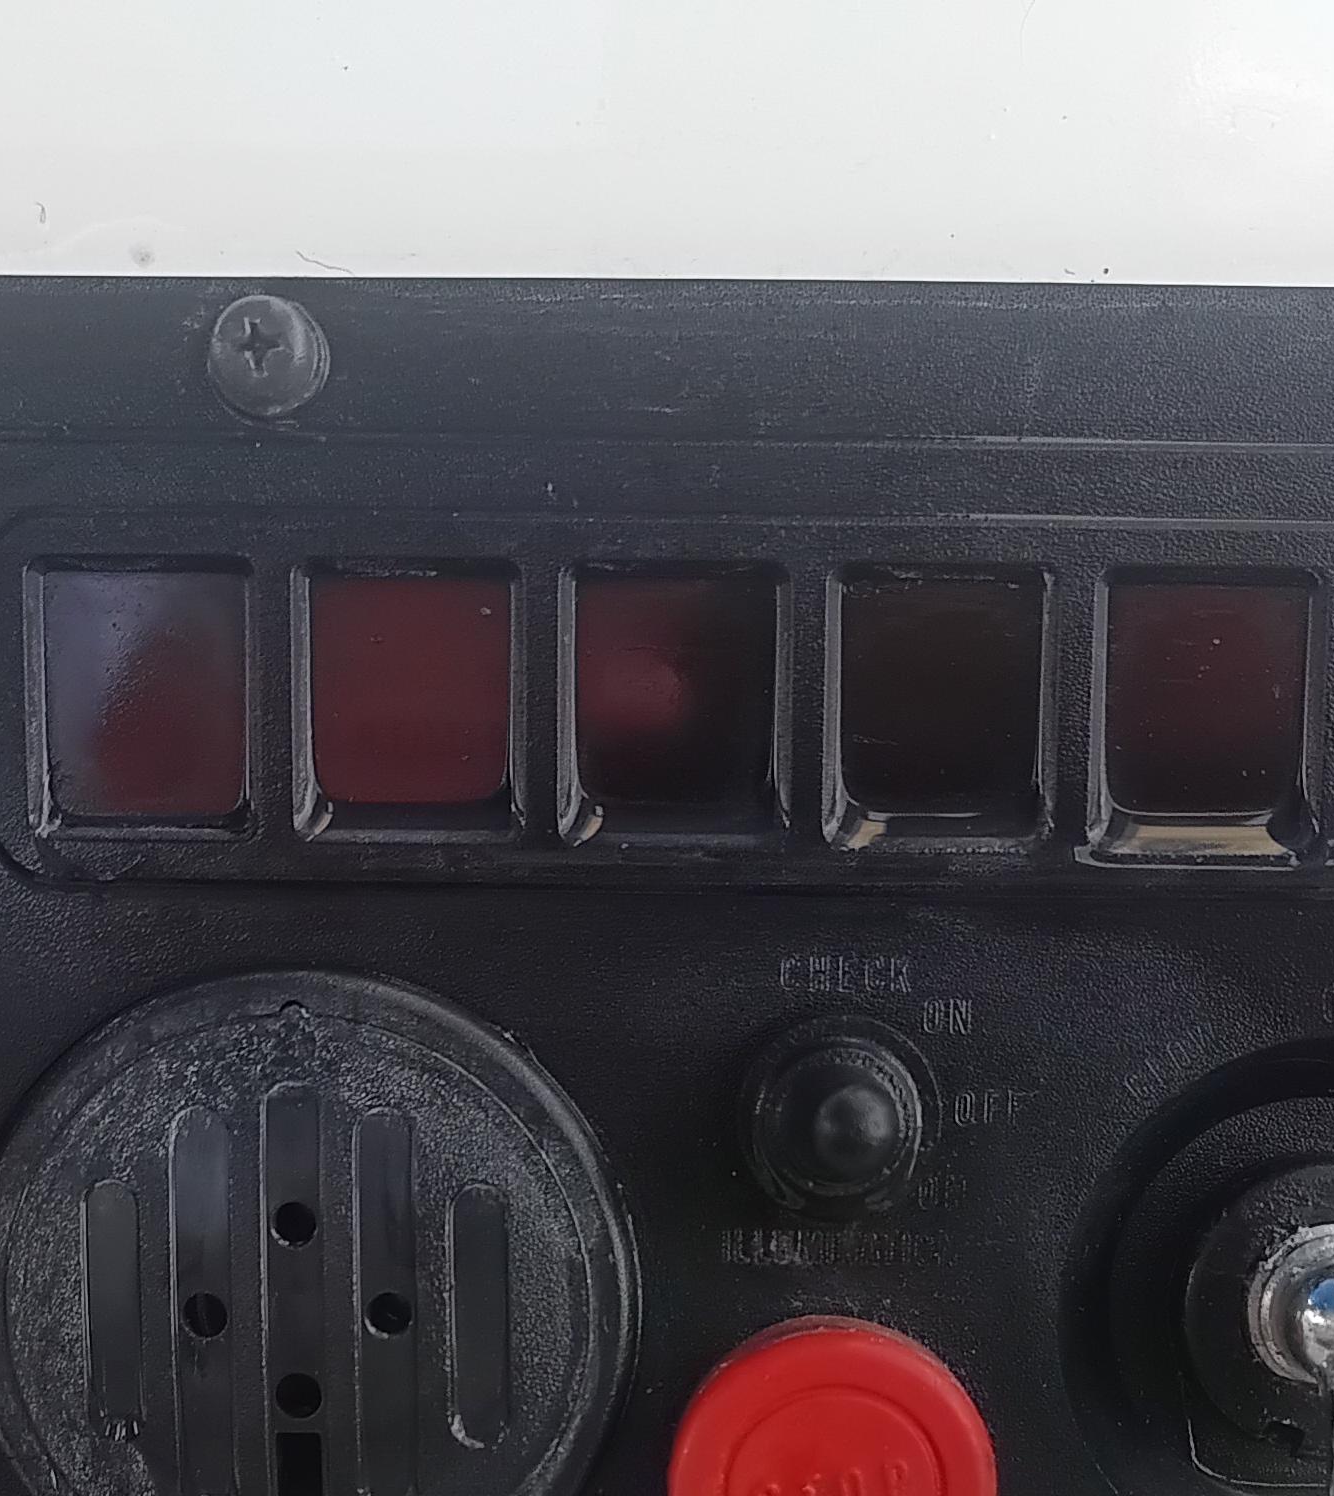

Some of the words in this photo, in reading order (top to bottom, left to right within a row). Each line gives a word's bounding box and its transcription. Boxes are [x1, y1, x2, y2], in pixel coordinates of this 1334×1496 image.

[779, 954, 913, 993] CHECK
[922, 998, 973, 1036] ON
[953, 1088, 1029, 1127] OFF
